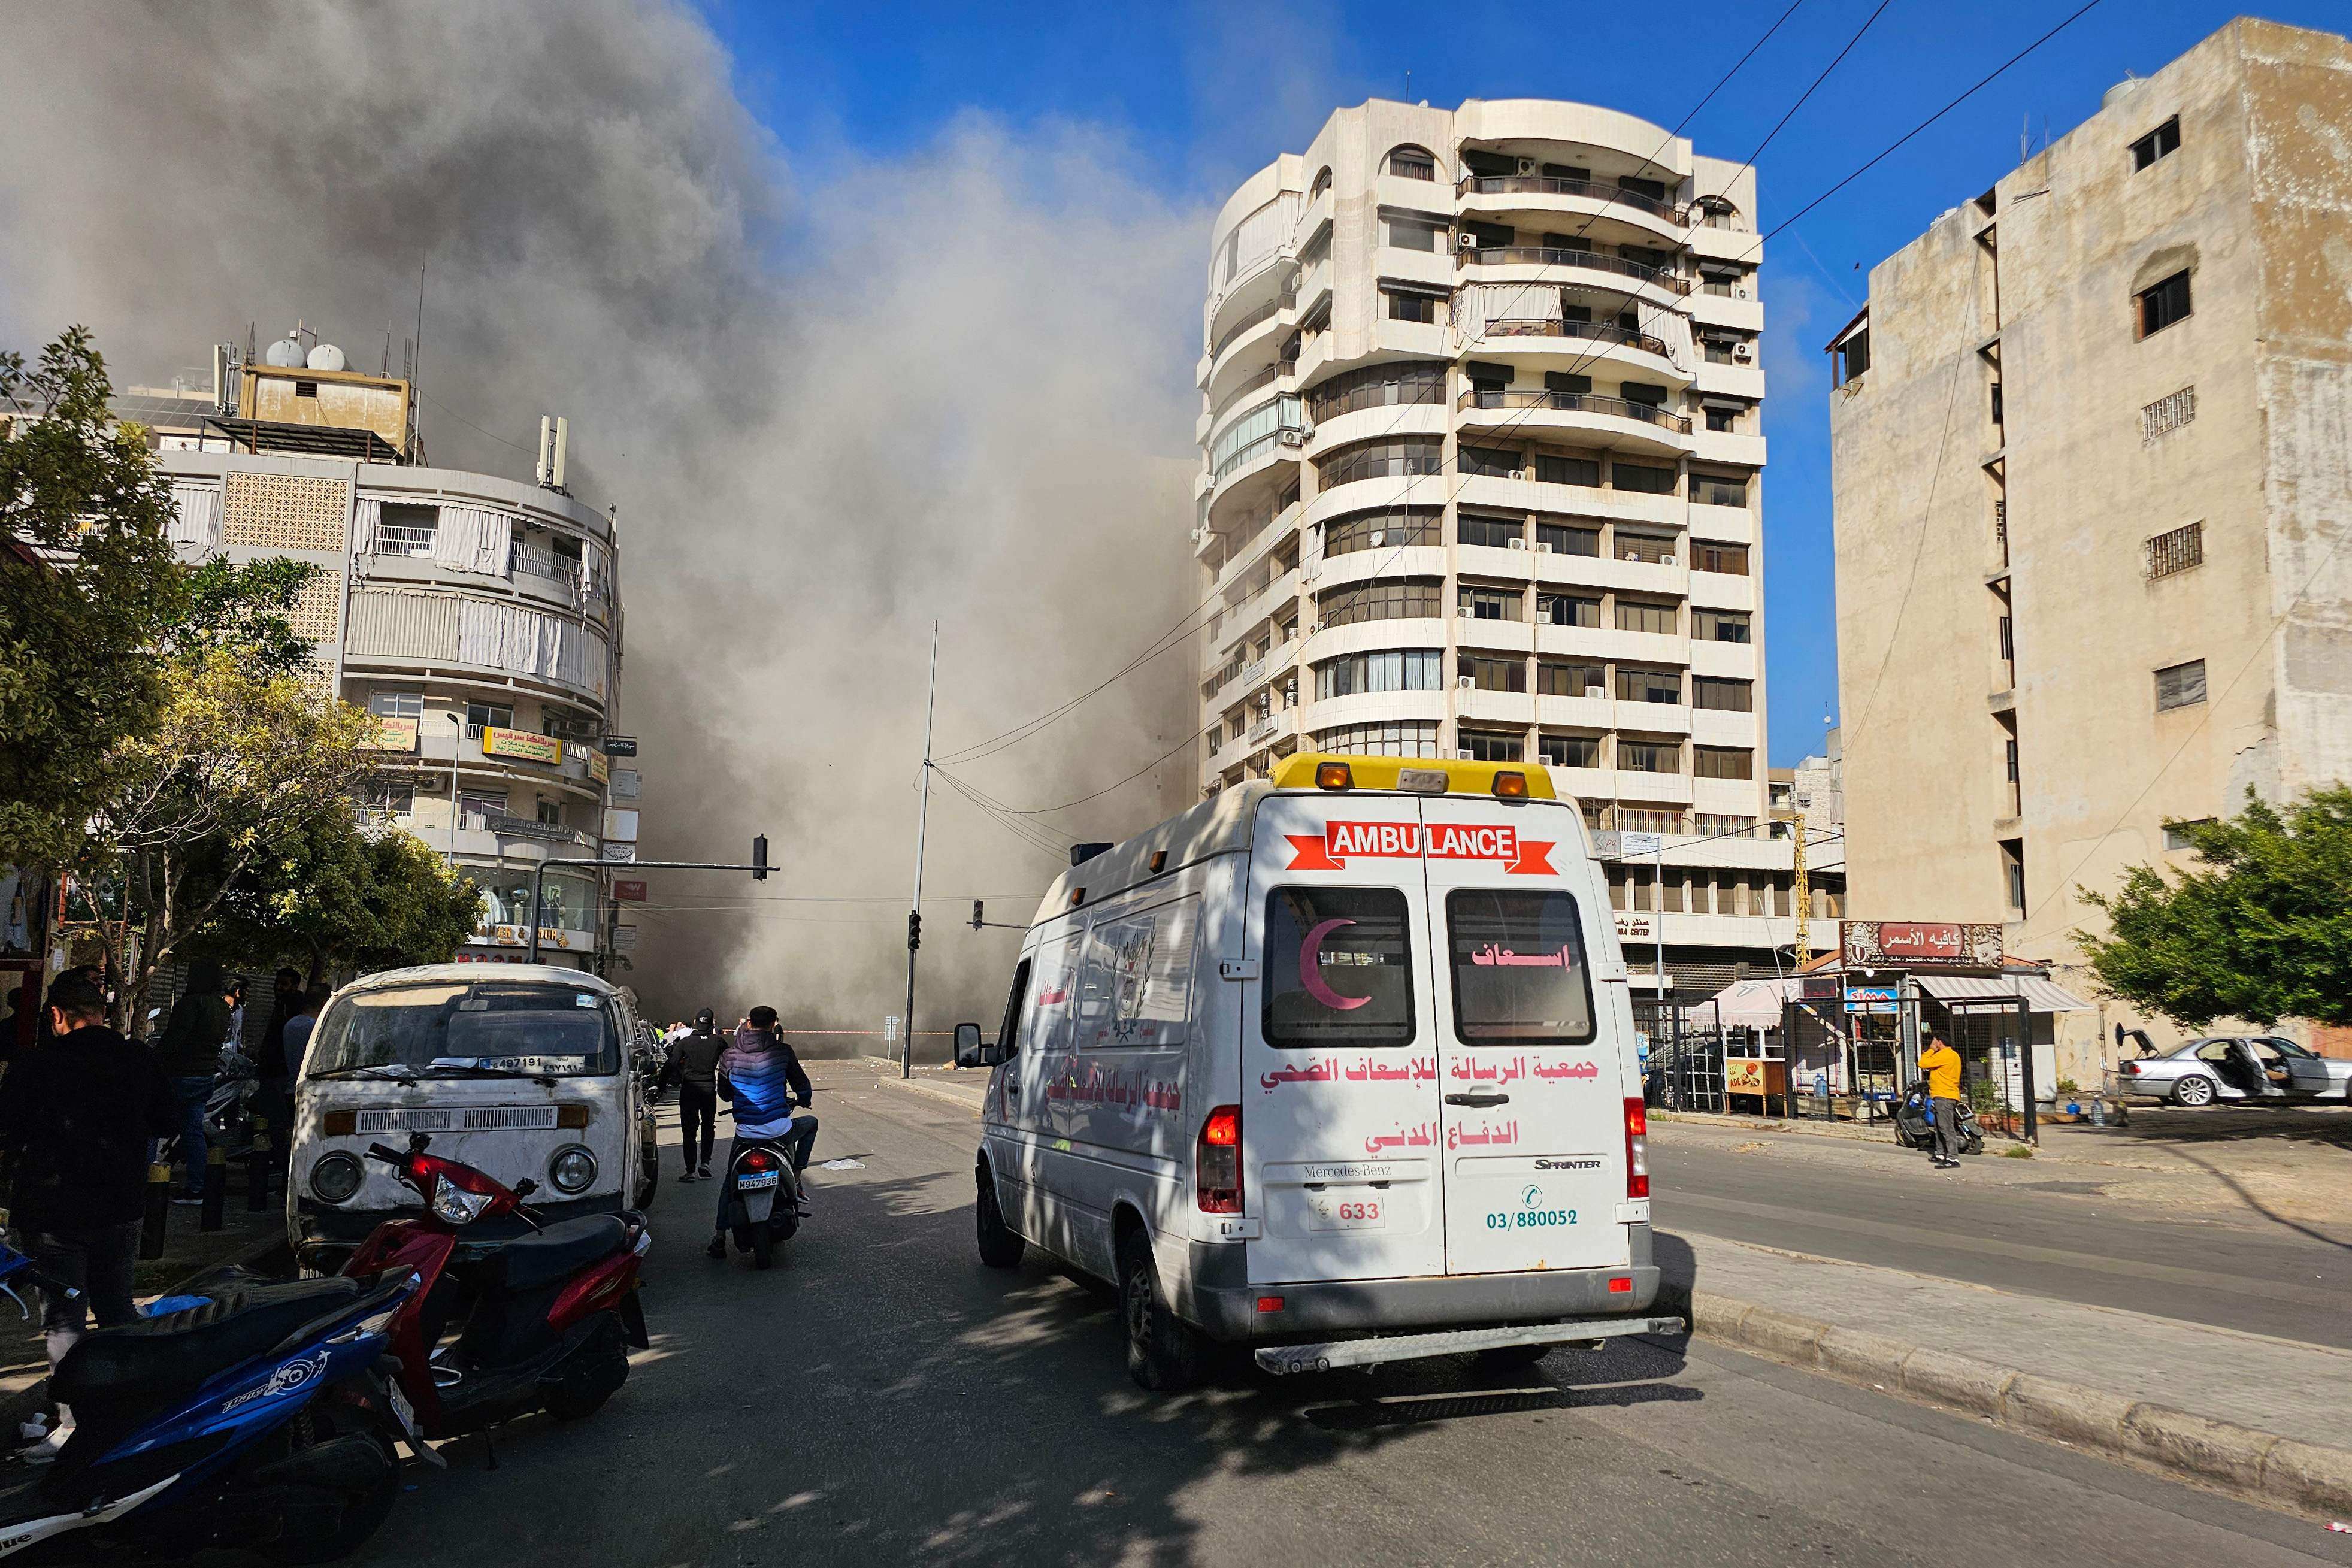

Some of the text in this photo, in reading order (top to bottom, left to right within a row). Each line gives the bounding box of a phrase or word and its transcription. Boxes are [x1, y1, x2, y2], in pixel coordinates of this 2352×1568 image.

[382, 721, 414, 731] سريلانك
[526, 734, 556, 747] سريلانكا
[531, 823, 563, 833] السياحة
[1333, 825, 1513, 856] AMBULANCE
[1882, 928, 1960, 949] كافيه الأسمر
[1472, 942, 1571, 973] إسعاف
[1851, 991, 1889, 1001] SIMA
[499, 1058, 541, 1068] 497191
[543, 1064, 577, 1073] ٤٩٧١٩١
[1451, 1056, 1527, 1086] الرسالة
[1533, 1055, 1599, 1084] جمعية
[1345, 1056, 1436, 1091] للإسعاف
[1365, 1119, 1518, 1160] الدفاع المدني
[1304, 1164, 1391, 1178] Mercedes-Benz
[739, 1177, 777, 1189] M947936
[1339, 1203, 1379, 1219] 633
[1487, 1209, 1577, 1232] 03/880052
